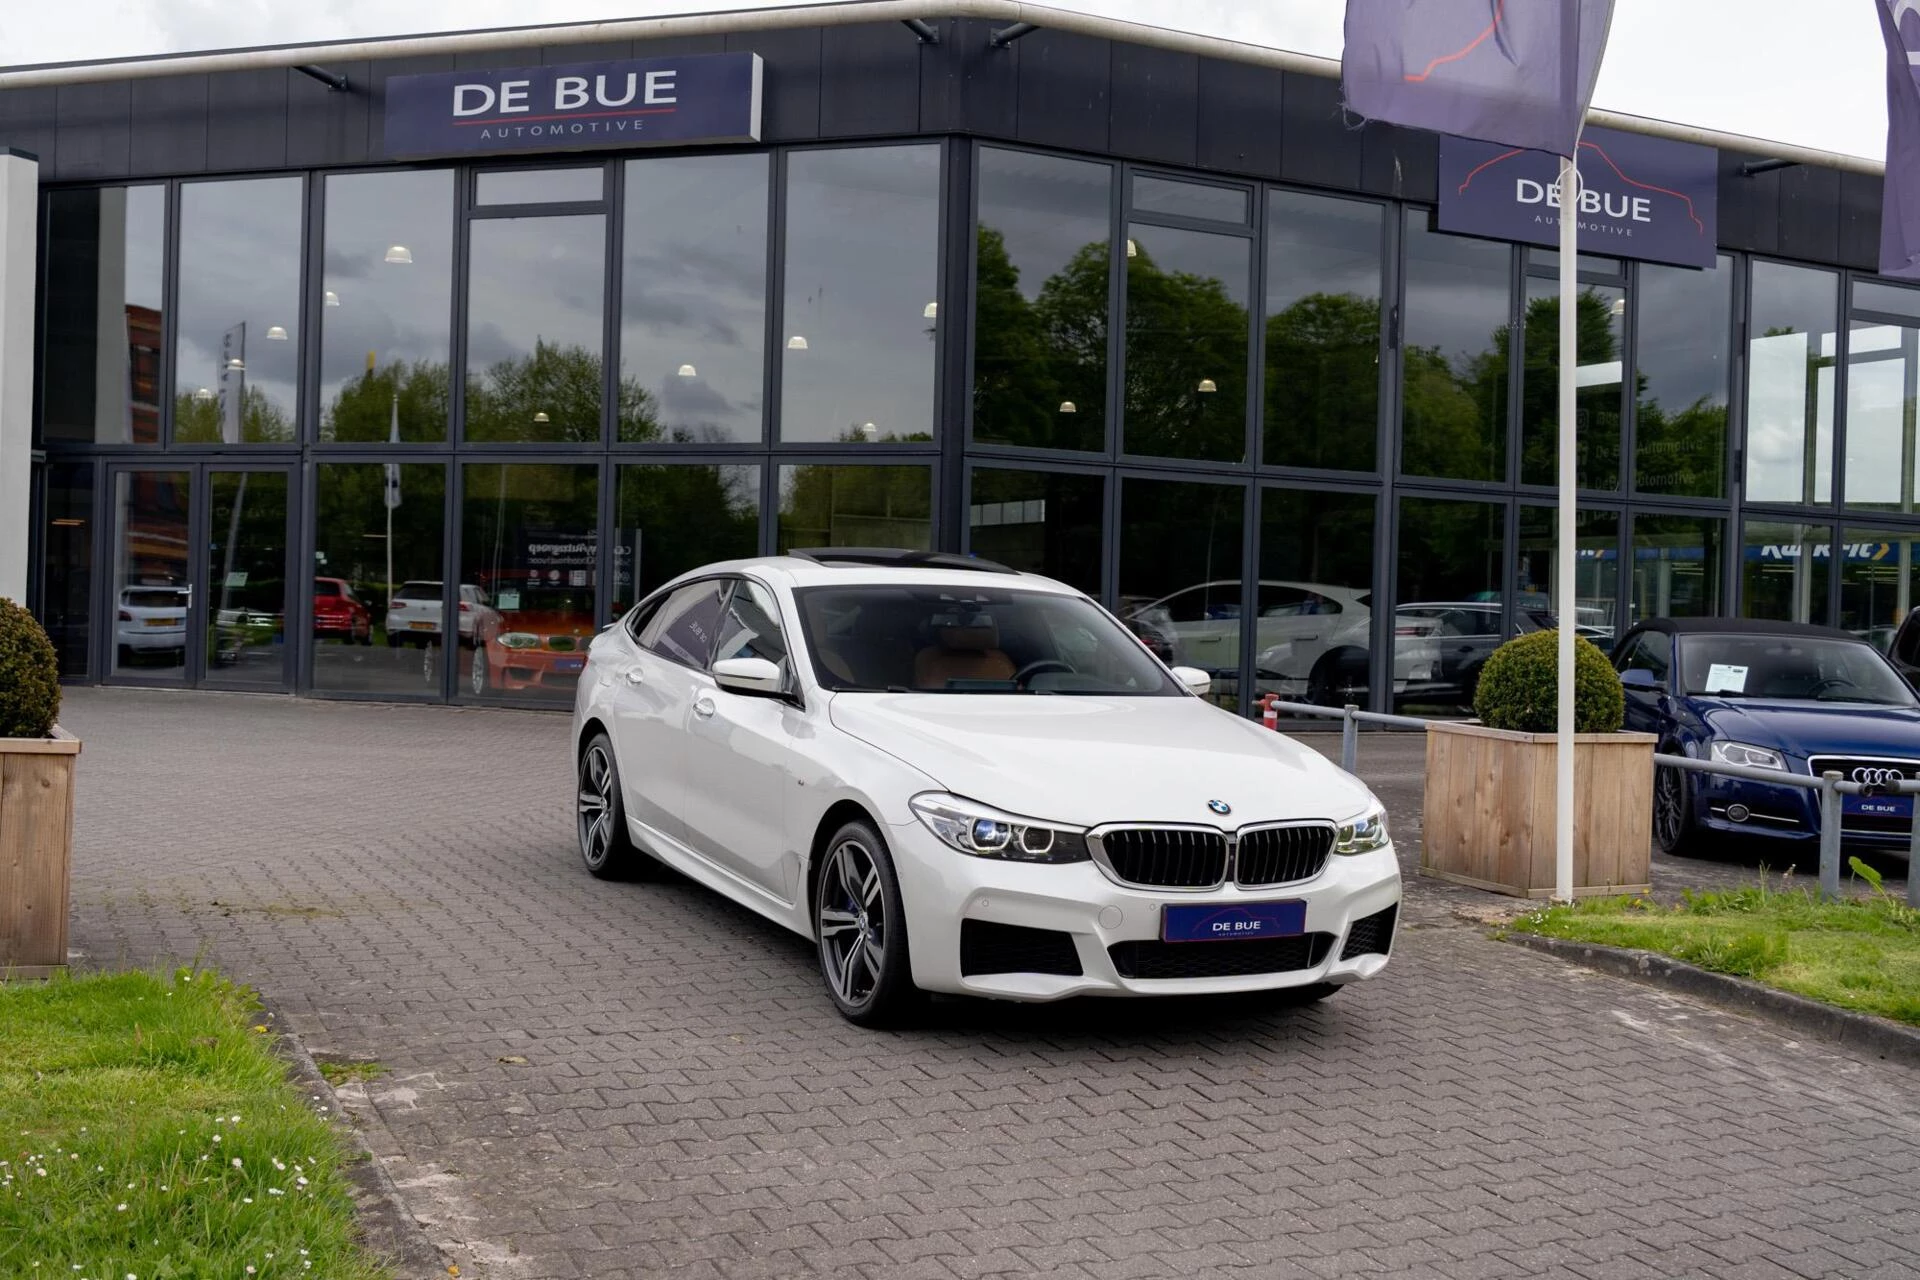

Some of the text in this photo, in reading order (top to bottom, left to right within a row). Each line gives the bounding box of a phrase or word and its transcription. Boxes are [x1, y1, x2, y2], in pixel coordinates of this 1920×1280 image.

[453, 70, 677, 117] DE BUE
[480, 119, 644, 140] AUTOMOTIVE
[1516, 178, 1652, 223] DE BUE
[1534, 214, 1634, 237] AUTMOTIVE
[1212, 920, 1261, 931] DE BUE
